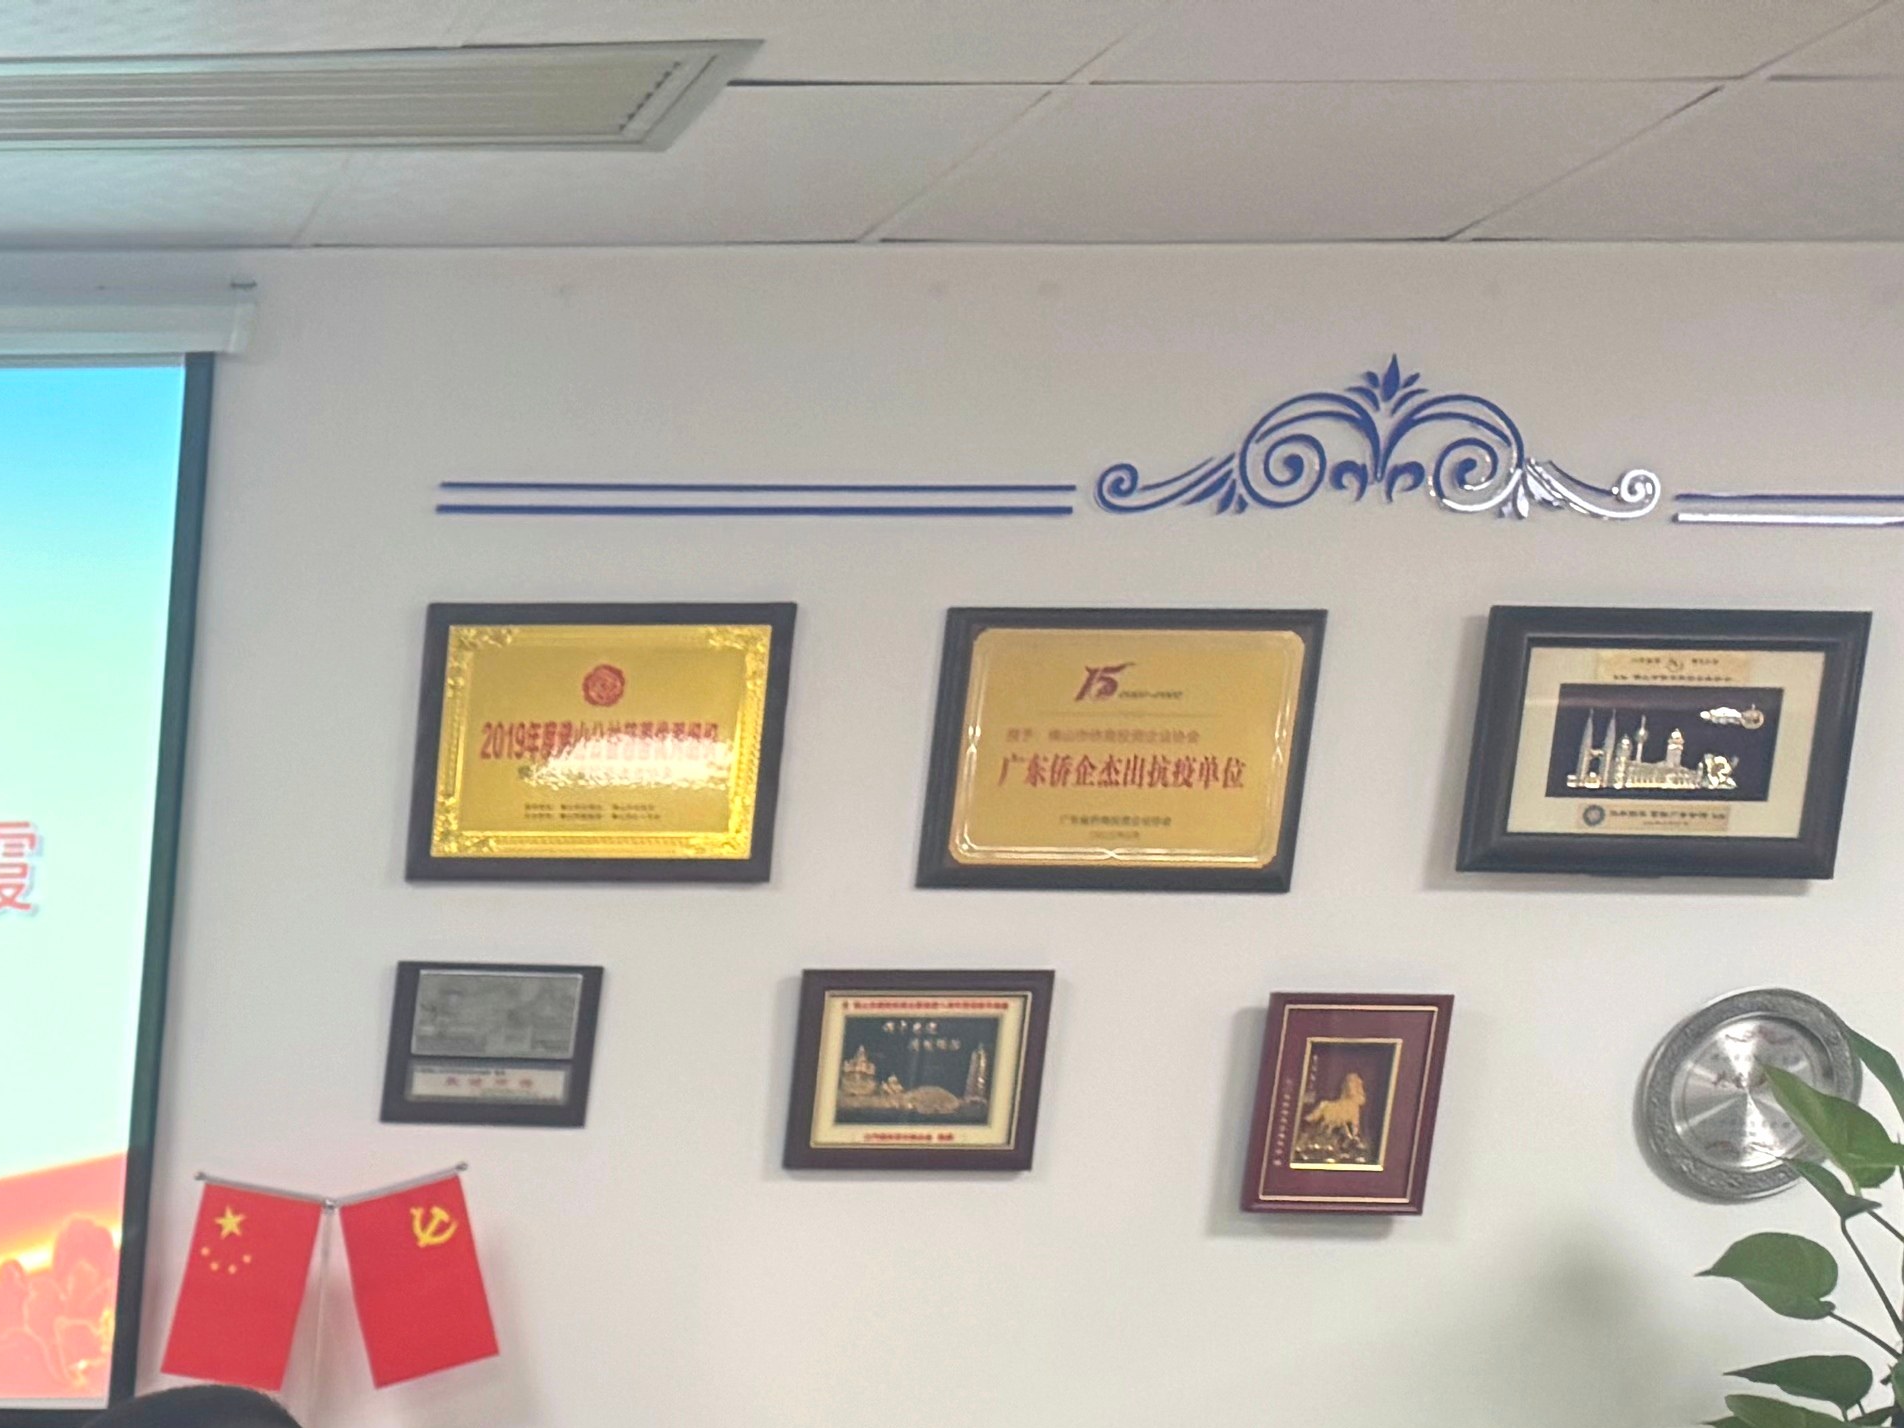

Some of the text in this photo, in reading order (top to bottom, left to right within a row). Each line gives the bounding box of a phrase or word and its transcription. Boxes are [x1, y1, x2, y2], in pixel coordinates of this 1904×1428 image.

[998, 753, 1247, 790] 广东侨企杰出抗疫单位
